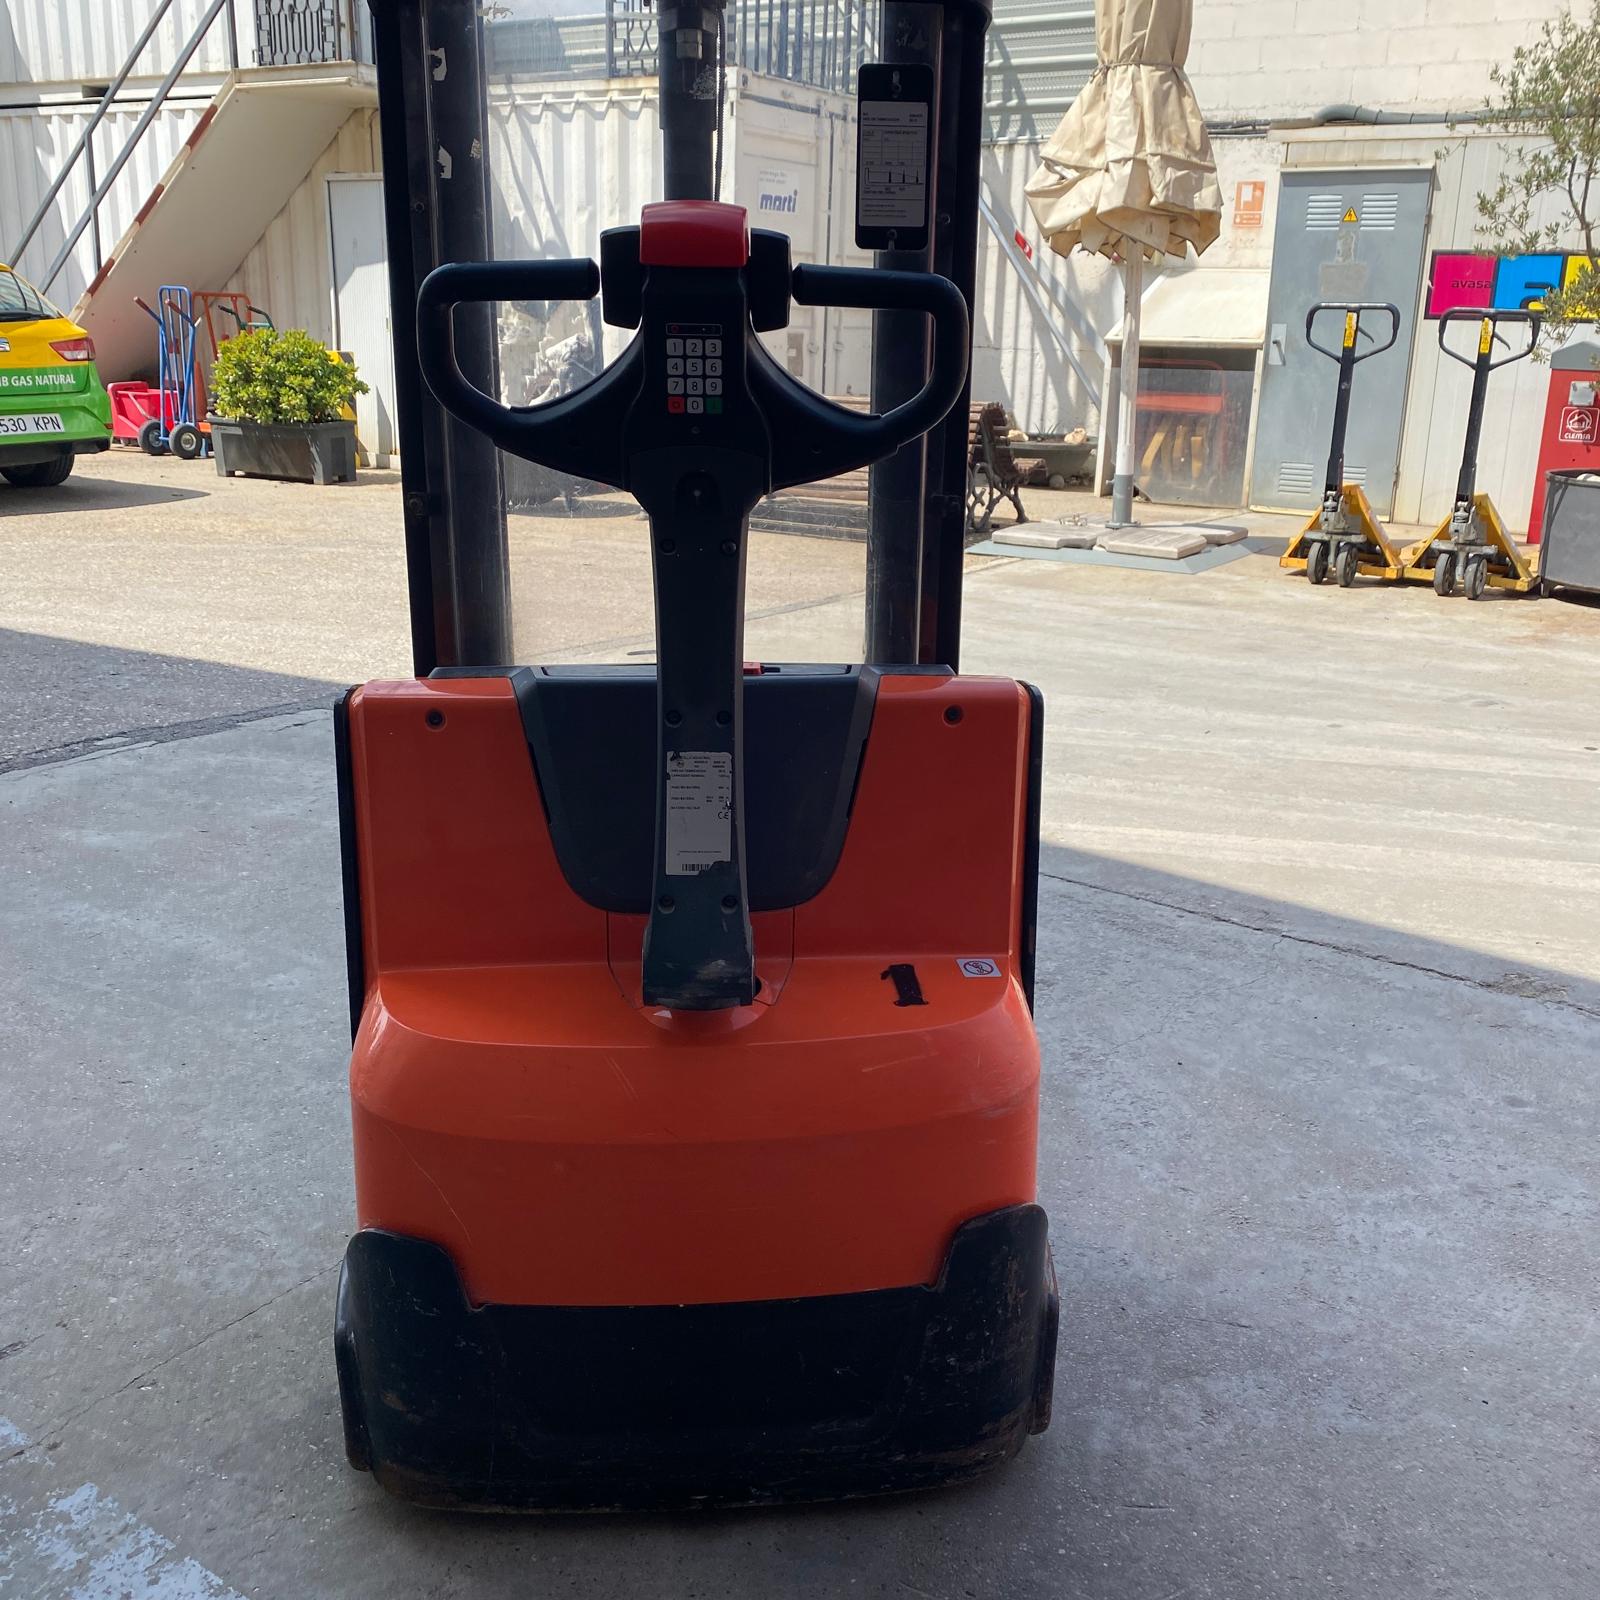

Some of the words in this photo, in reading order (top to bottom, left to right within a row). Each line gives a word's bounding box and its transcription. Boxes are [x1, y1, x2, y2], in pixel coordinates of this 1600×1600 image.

[760, 189, 798, 213] marti
[1451, 279, 1493, 289] avasa
[691, 342, 697, 352] 2
[710, 342, 717, 353] 3
[671, 362, 678, 372] 4
[691, 362, 698, 372] 5
[710, 362, 717, 372] 6
[11, 375, 33, 387] GAS
[35, 374, 76, 386] NATURAL
[672, 381, 679, 391] 7
[691, 381, 698, 391] 8
[710, 381, 717, 391] 9
[0, 417, 27, 433] 530
[33, 416, 61, 432] KPN
